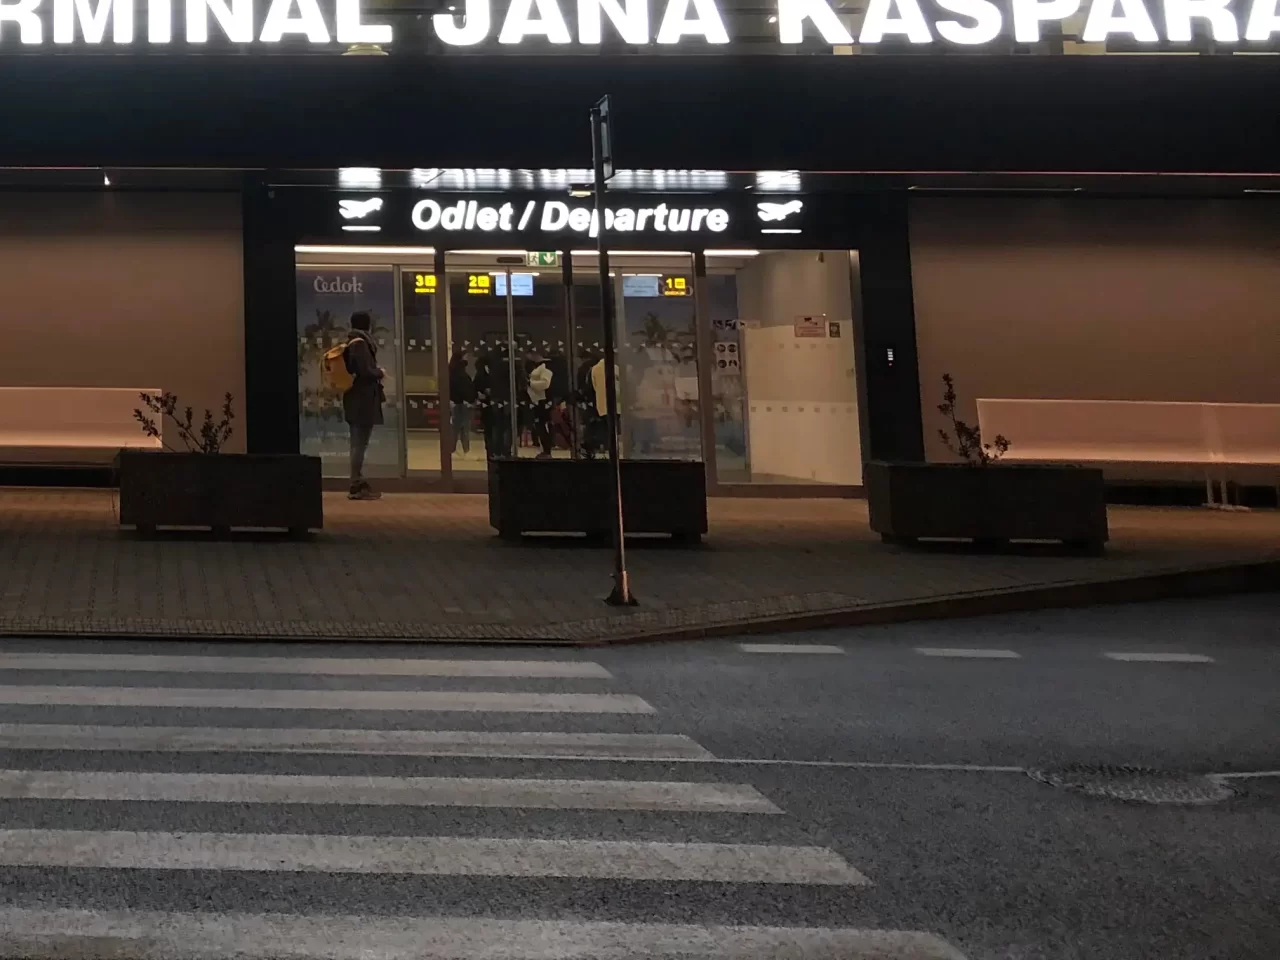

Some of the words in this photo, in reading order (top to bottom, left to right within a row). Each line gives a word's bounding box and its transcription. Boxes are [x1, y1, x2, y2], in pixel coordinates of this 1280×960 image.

[411, 199, 514, 231] Odlet
[517, 200, 536, 231] /
[540, 201, 730, 238] Departure
[313, 275, 364, 292] Čedok
[415, 274, 425, 287] 3
[468, 275, 478, 288] 2
[665, 277, 673, 289] 1
